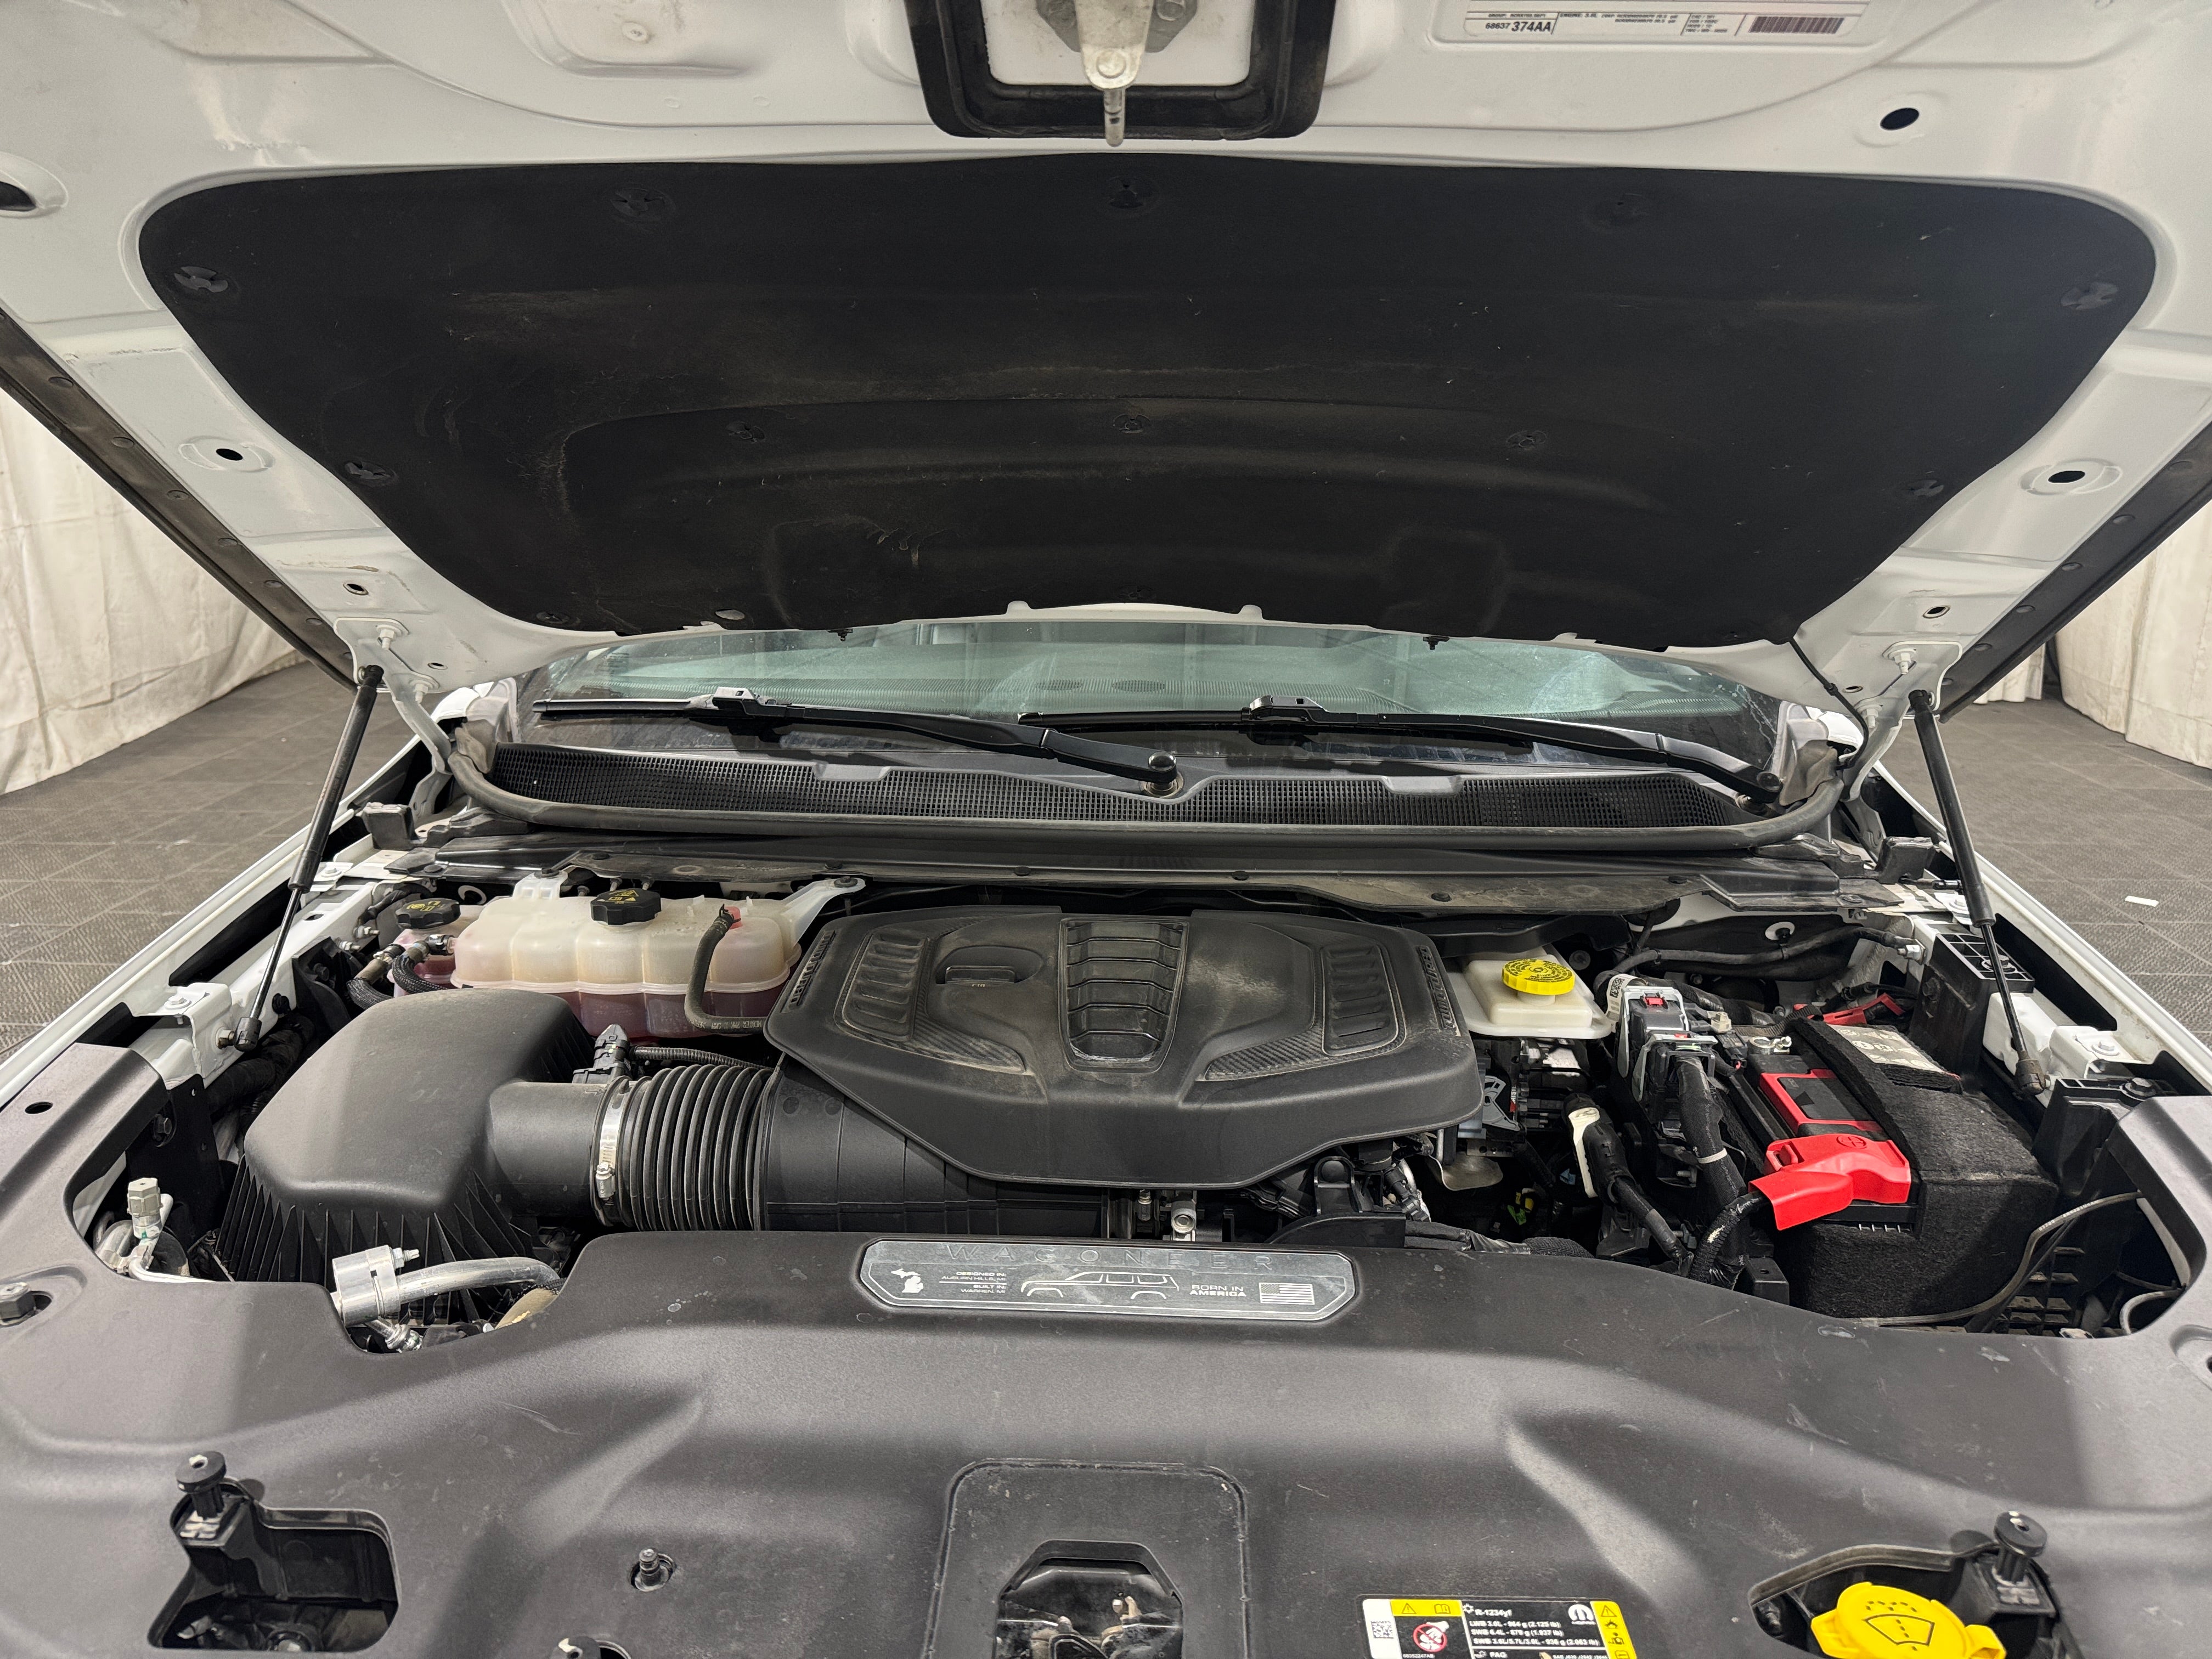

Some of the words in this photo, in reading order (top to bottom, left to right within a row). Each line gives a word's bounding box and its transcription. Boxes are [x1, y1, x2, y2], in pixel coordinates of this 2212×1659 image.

[1511, 21, 1551, 32] 374AA
[946, 1244, 1273, 1271] WAGONEER
[1475, 1609, 1513, 1617] R-1234yf
